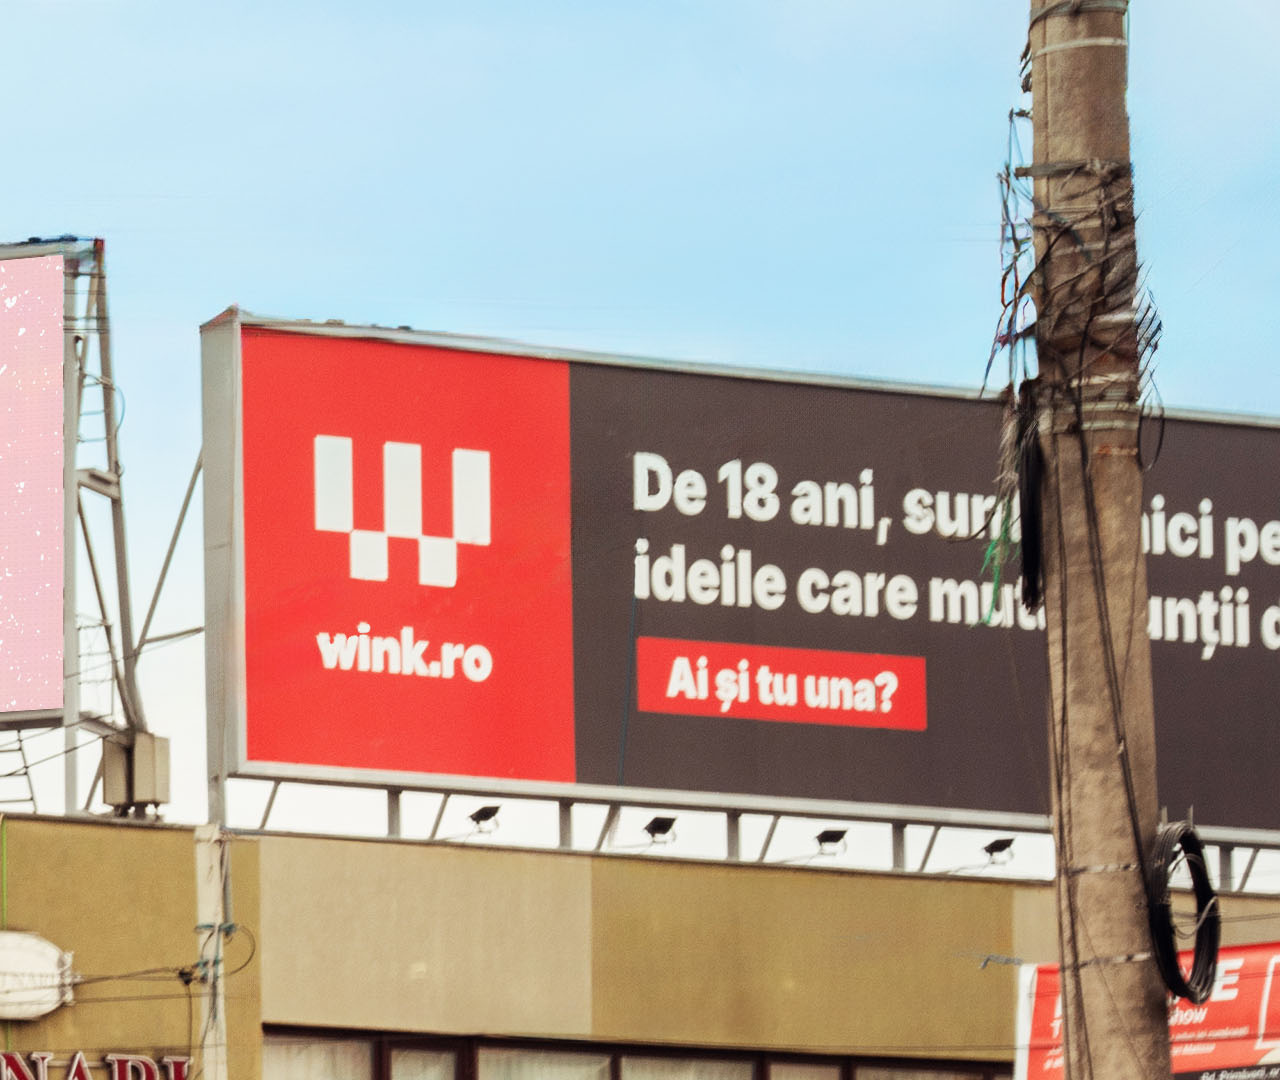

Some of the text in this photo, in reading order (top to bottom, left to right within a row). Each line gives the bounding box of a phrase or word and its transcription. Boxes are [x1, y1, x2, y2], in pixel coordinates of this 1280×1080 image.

[633, 452, 708, 516] De
[718, 459, 780, 522] 18
[790, 468, 892, 546] ani,
[1141, 494, 1214, 559] ici
[634, 538, 787, 610] ideile
[797, 567, 919, 620] care
[316, 621, 493, 683] wink.ro
[666, 655, 899, 713] Ai și tu una?
